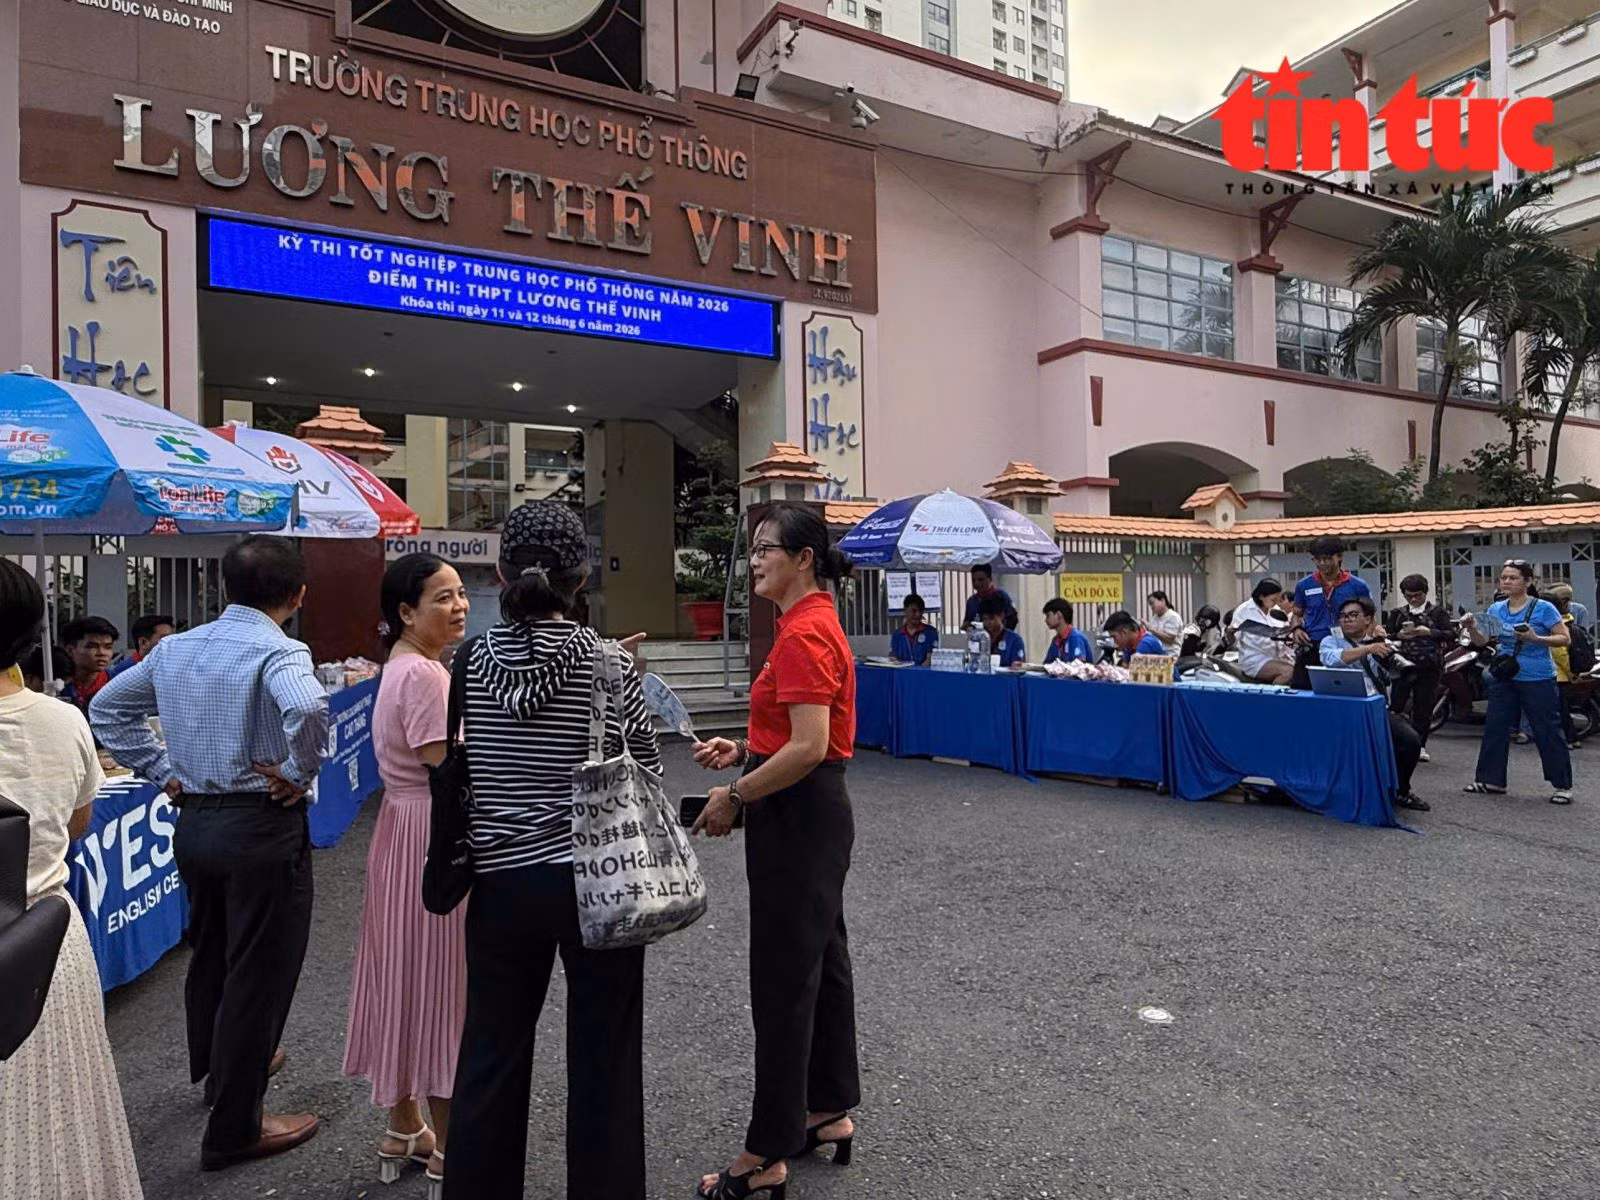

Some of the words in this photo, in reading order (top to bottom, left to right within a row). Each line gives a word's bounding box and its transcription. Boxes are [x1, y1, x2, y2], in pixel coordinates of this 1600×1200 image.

[112, 0, 140, 16] DỤC
[143, 4, 160, 20] VÀ
[162, 8, 190, 27] ĐÀO
[194, 17, 221, 34] TẠO
[264, 45, 408, 108] TRƯỜNG
[414, 79, 521, 131] TRUNG
[529, 106, 590, 148] HỌC
[598, 116, 654, 160] PHỔ
[660, 135, 748, 181] THÔNG
[112, 93, 456, 227] LƯƠNG
[491, 167, 653, 256] THẾ
[680, 201, 853, 289] VINH
[60, 227, 157, 302] Tiên
[278, 234, 304, 250] KỲ
[310, 240, 342, 256] THI
[349, 243, 384, 262] TỐT
[391, 251, 457, 274] NGHIỆP
[462, 262, 520, 282] TRUNG
[526, 271, 559, 289] HỌC
[564, 277, 597, 293] PHỔ
[602, 283, 655, 302] THÔNG
[660, 289, 693, 307] NĂM
[697, 297, 729, 312] 2026
[368, 269, 417, 289] ĐIỂM
[424, 277, 460, 295] THI:
[466, 284, 511, 302] THPT
[517, 290, 581, 312] LƯƠNG
[586, 300, 617, 317] THẾ
[621, 307, 661, 322] VINH
[400, 295, 434, 310] Khóa
[436, 301, 454, 313] thi
[458, 304, 488, 319] ngày
[491, 307, 504, 318] 11
[508, 310, 522, 321] và
[525, 312, 539, 323] 12
[542, 313, 576, 330] tháng
[578, 319, 585, 329] 6
[587, 320, 612, 332] năm
[615, 323, 641, 336] 2026
[808, 326, 856, 387] Hậu
[437, 538, 488, 559] người
[75, 792, 181, 920] V'ES
[107, 881, 163, 935] ENGLISH
